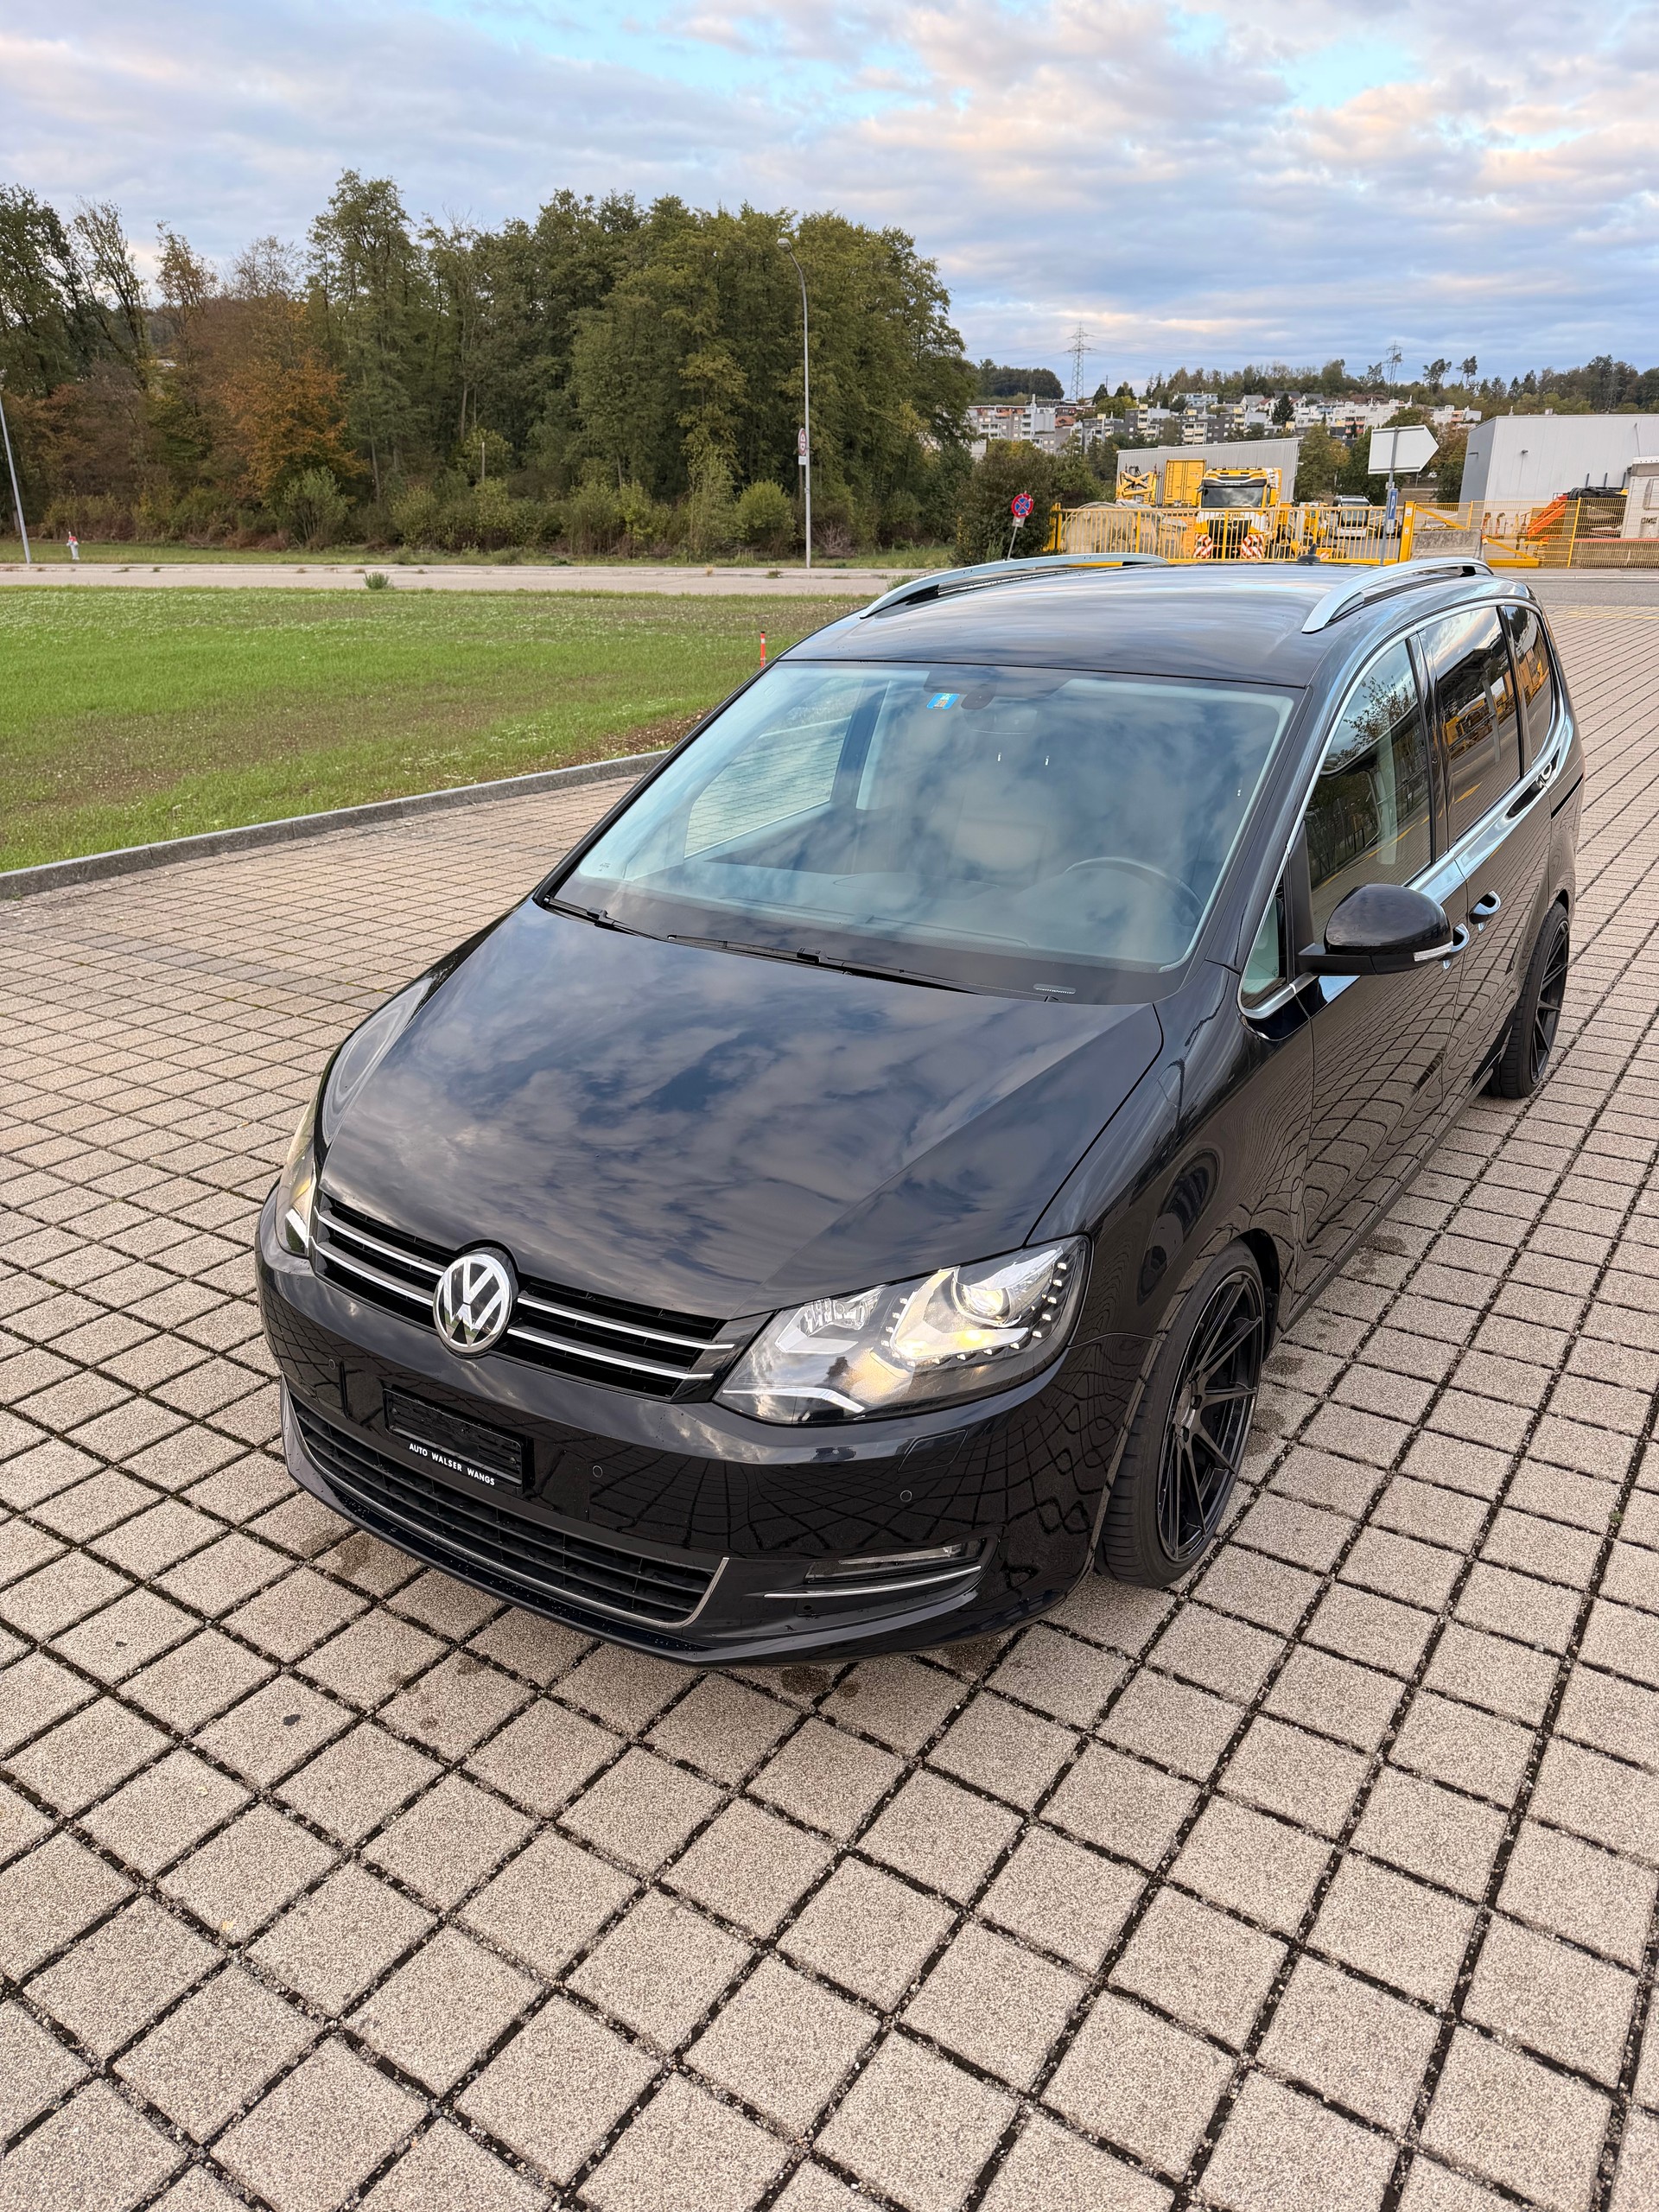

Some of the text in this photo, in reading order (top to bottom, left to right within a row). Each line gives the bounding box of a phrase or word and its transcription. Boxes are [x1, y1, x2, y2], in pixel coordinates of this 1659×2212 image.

[409, 1443, 495, 1486] AUTO WALSER WANGS
